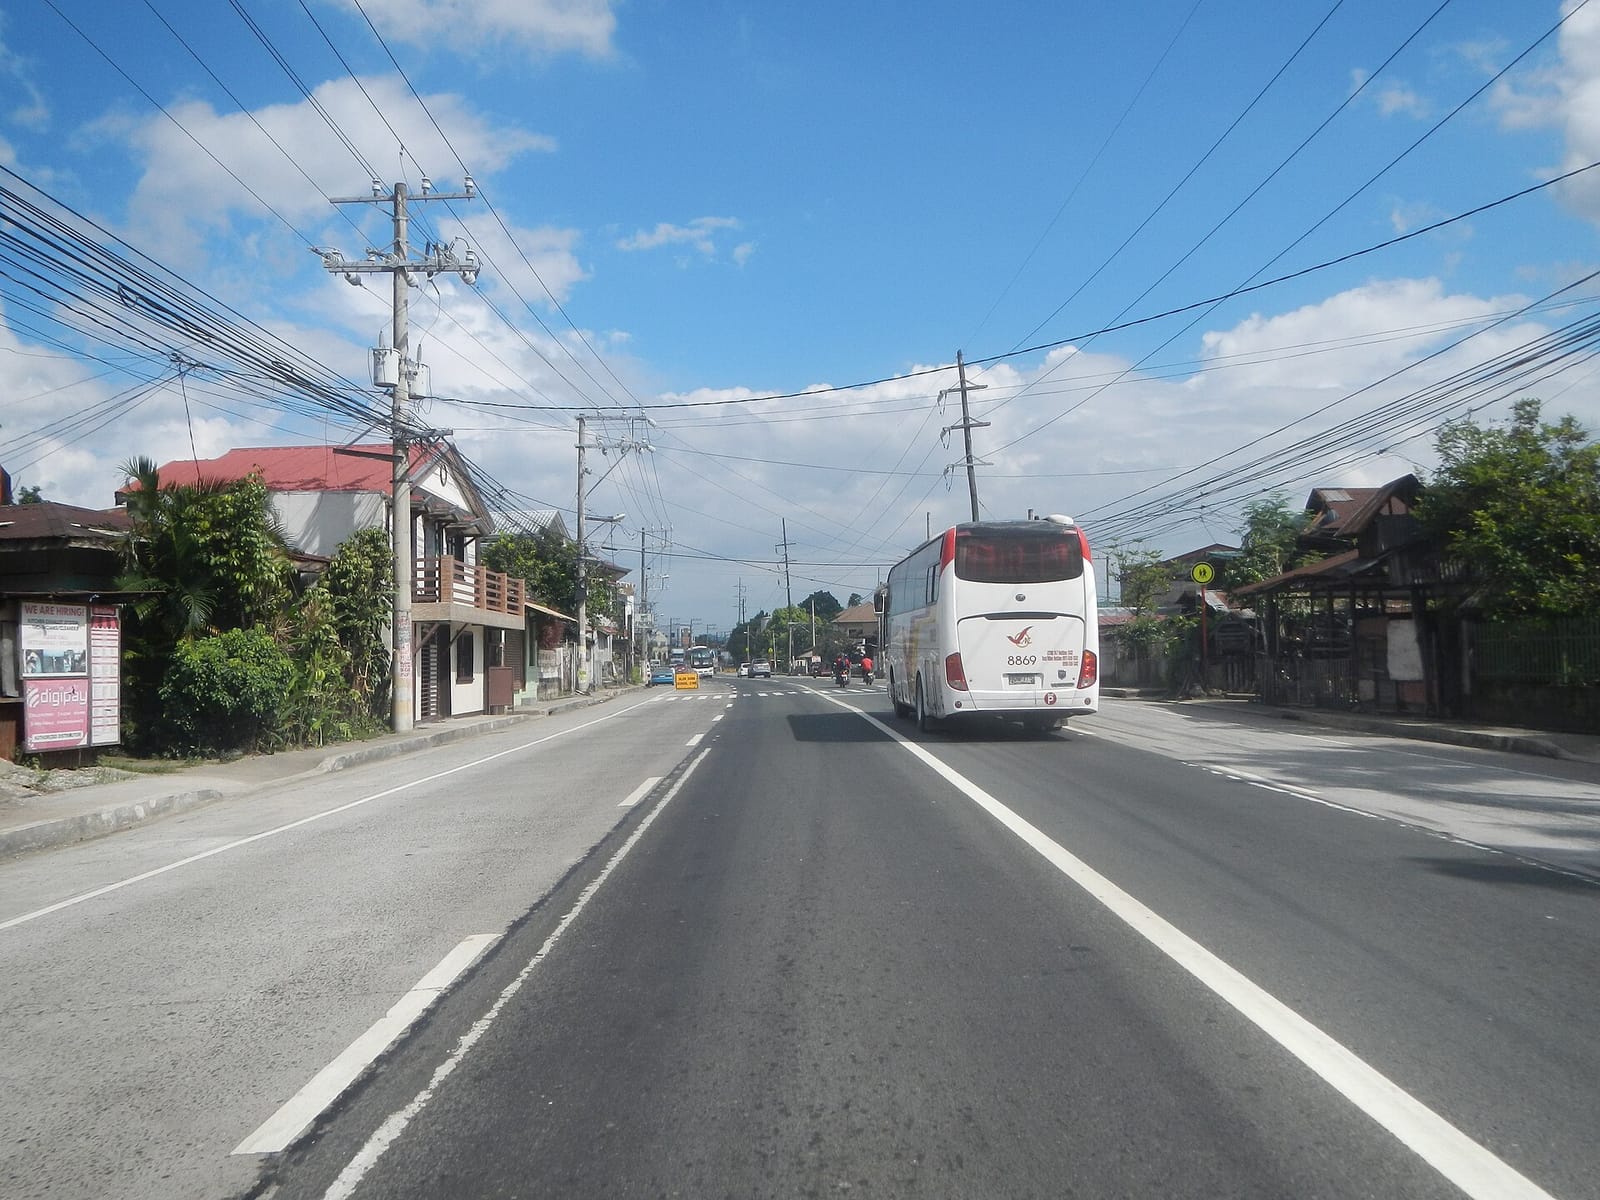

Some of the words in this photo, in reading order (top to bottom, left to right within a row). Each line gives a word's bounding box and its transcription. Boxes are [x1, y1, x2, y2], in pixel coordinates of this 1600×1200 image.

[24, 605, 38, 615] WE
[39, 606, 55, 616] ARE
[56, 606, 84, 617] HIRING!
[1007, 655, 1037, 666] 8869
[40, 688, 87, 706] digipay
